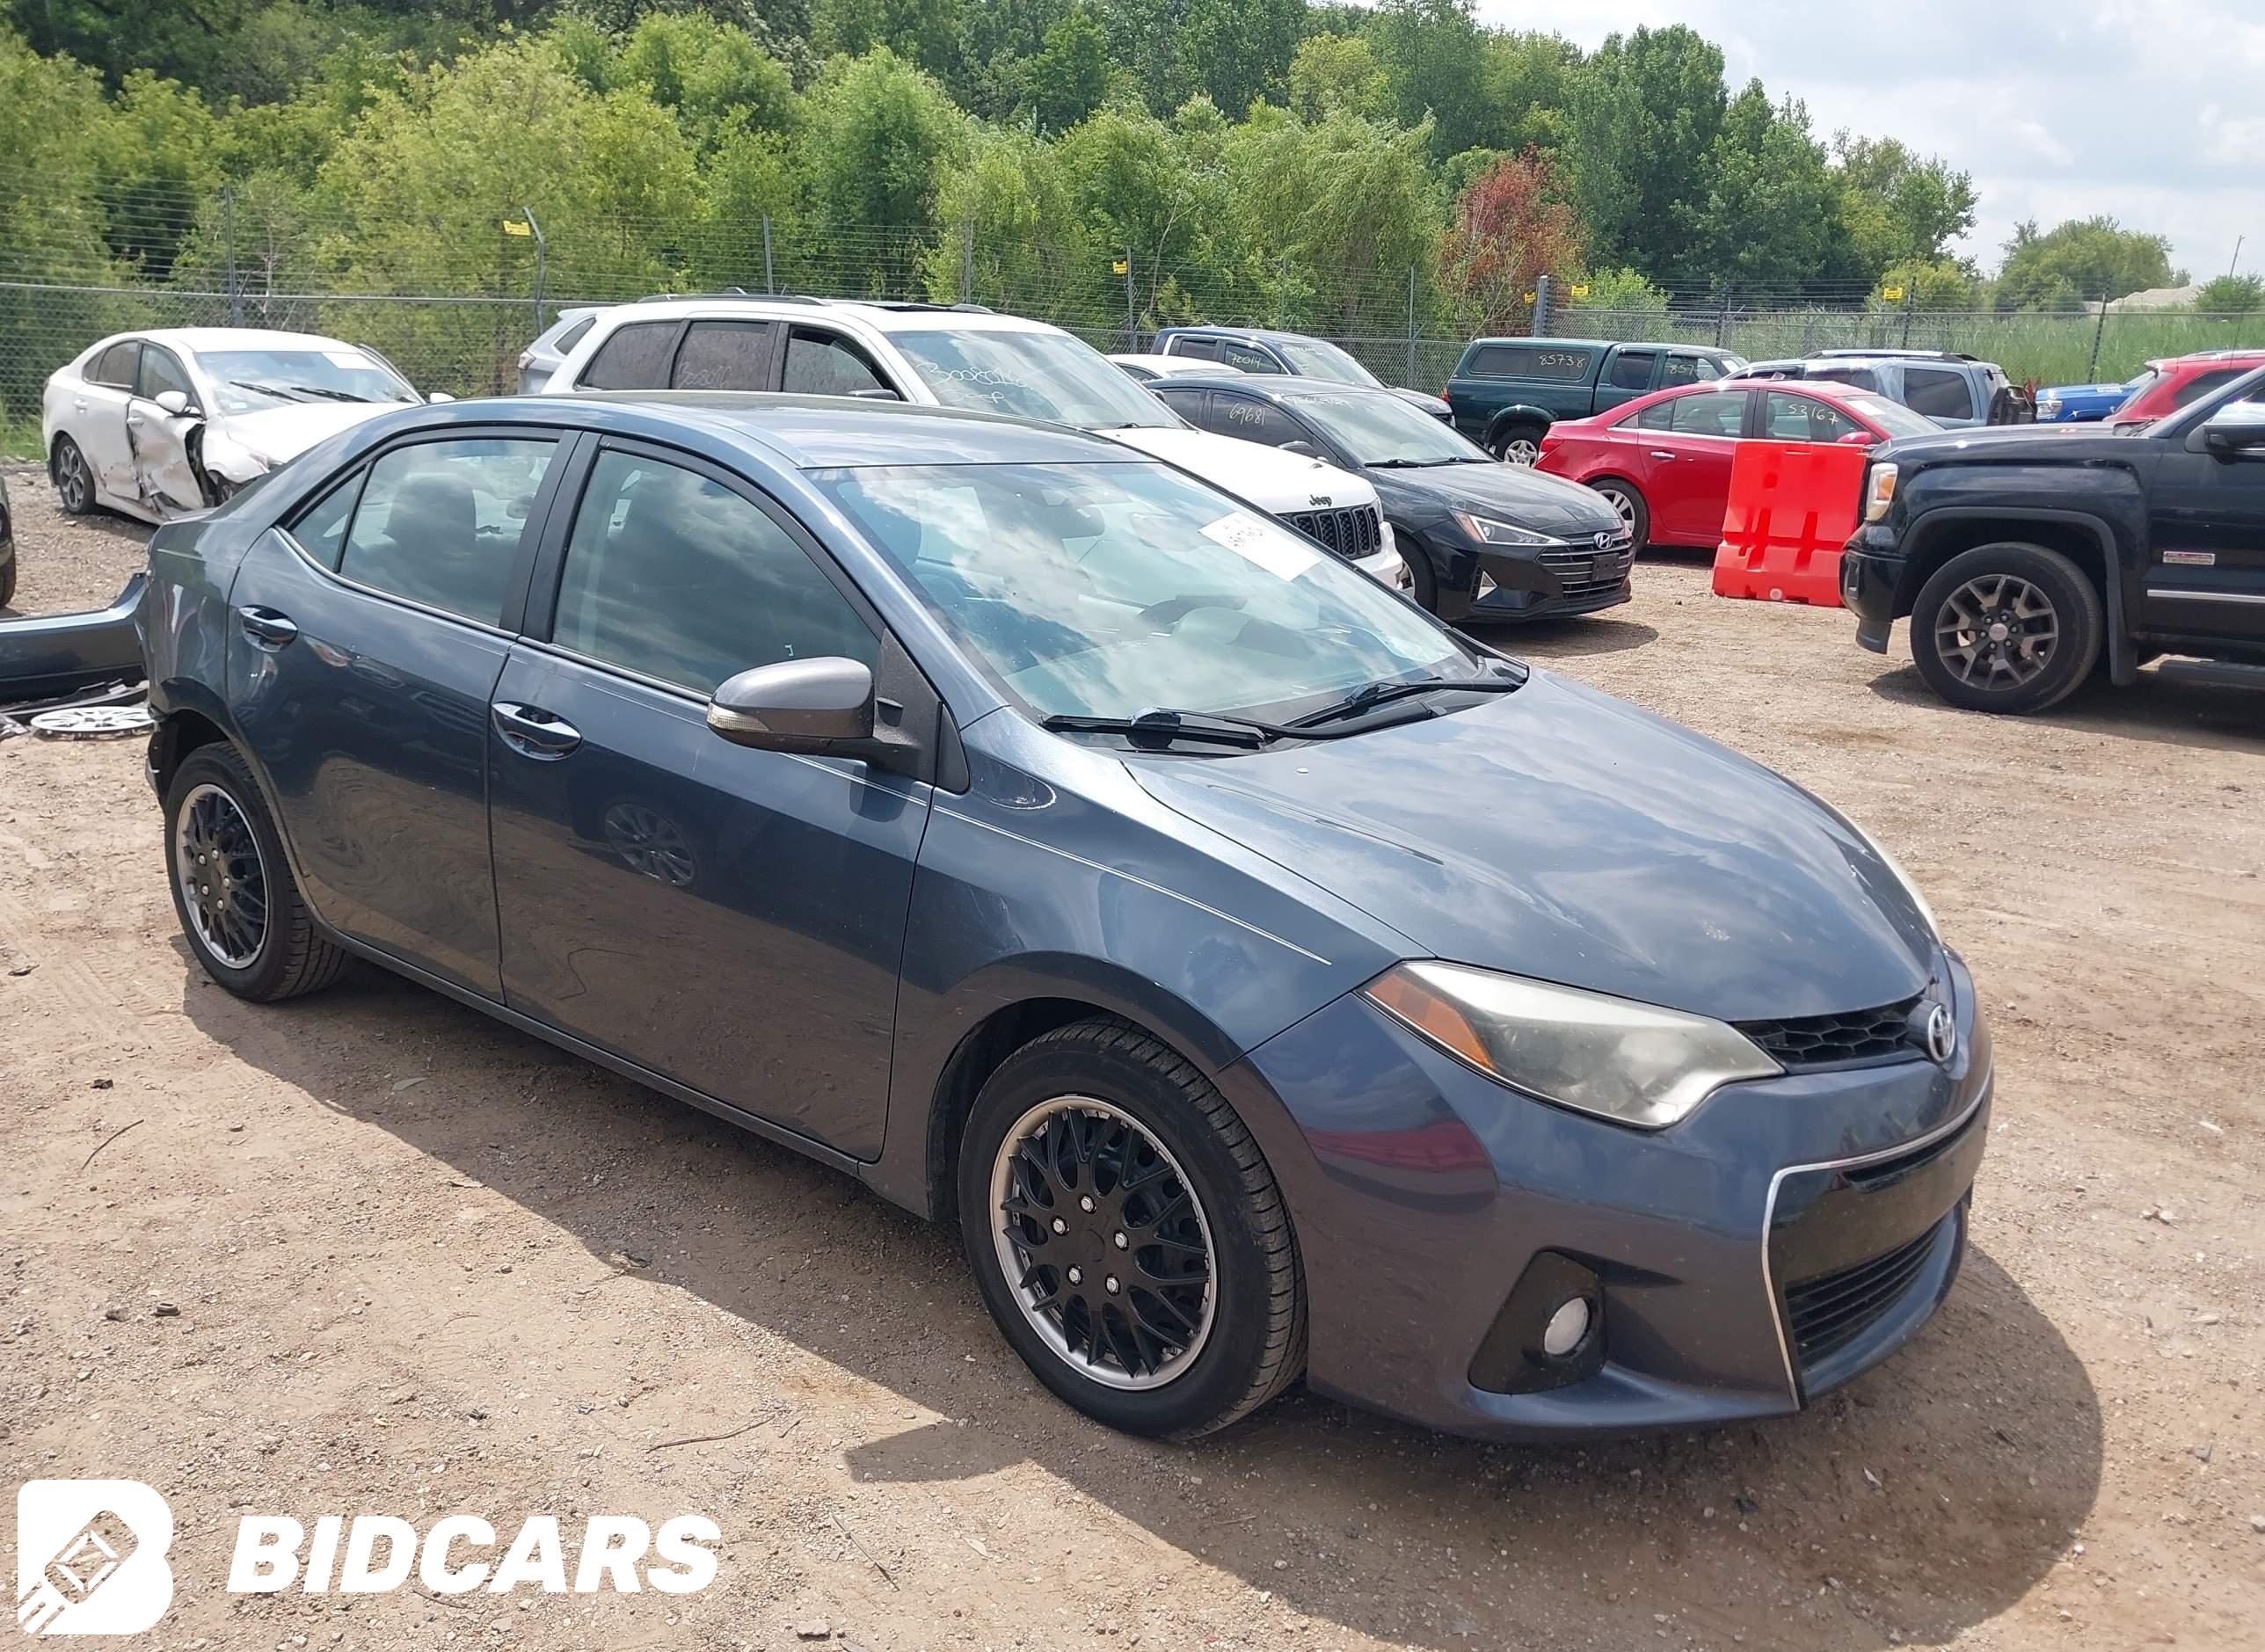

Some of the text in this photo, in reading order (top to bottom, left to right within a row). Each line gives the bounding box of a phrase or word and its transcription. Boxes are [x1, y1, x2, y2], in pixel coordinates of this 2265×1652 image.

[1539, 354, 1586, 368] 85738
[1229, 403, 1265, 426] 69681
[1788, 404, 1838, 425] 53167
[1309, 494, 1332, 507] Jeep
